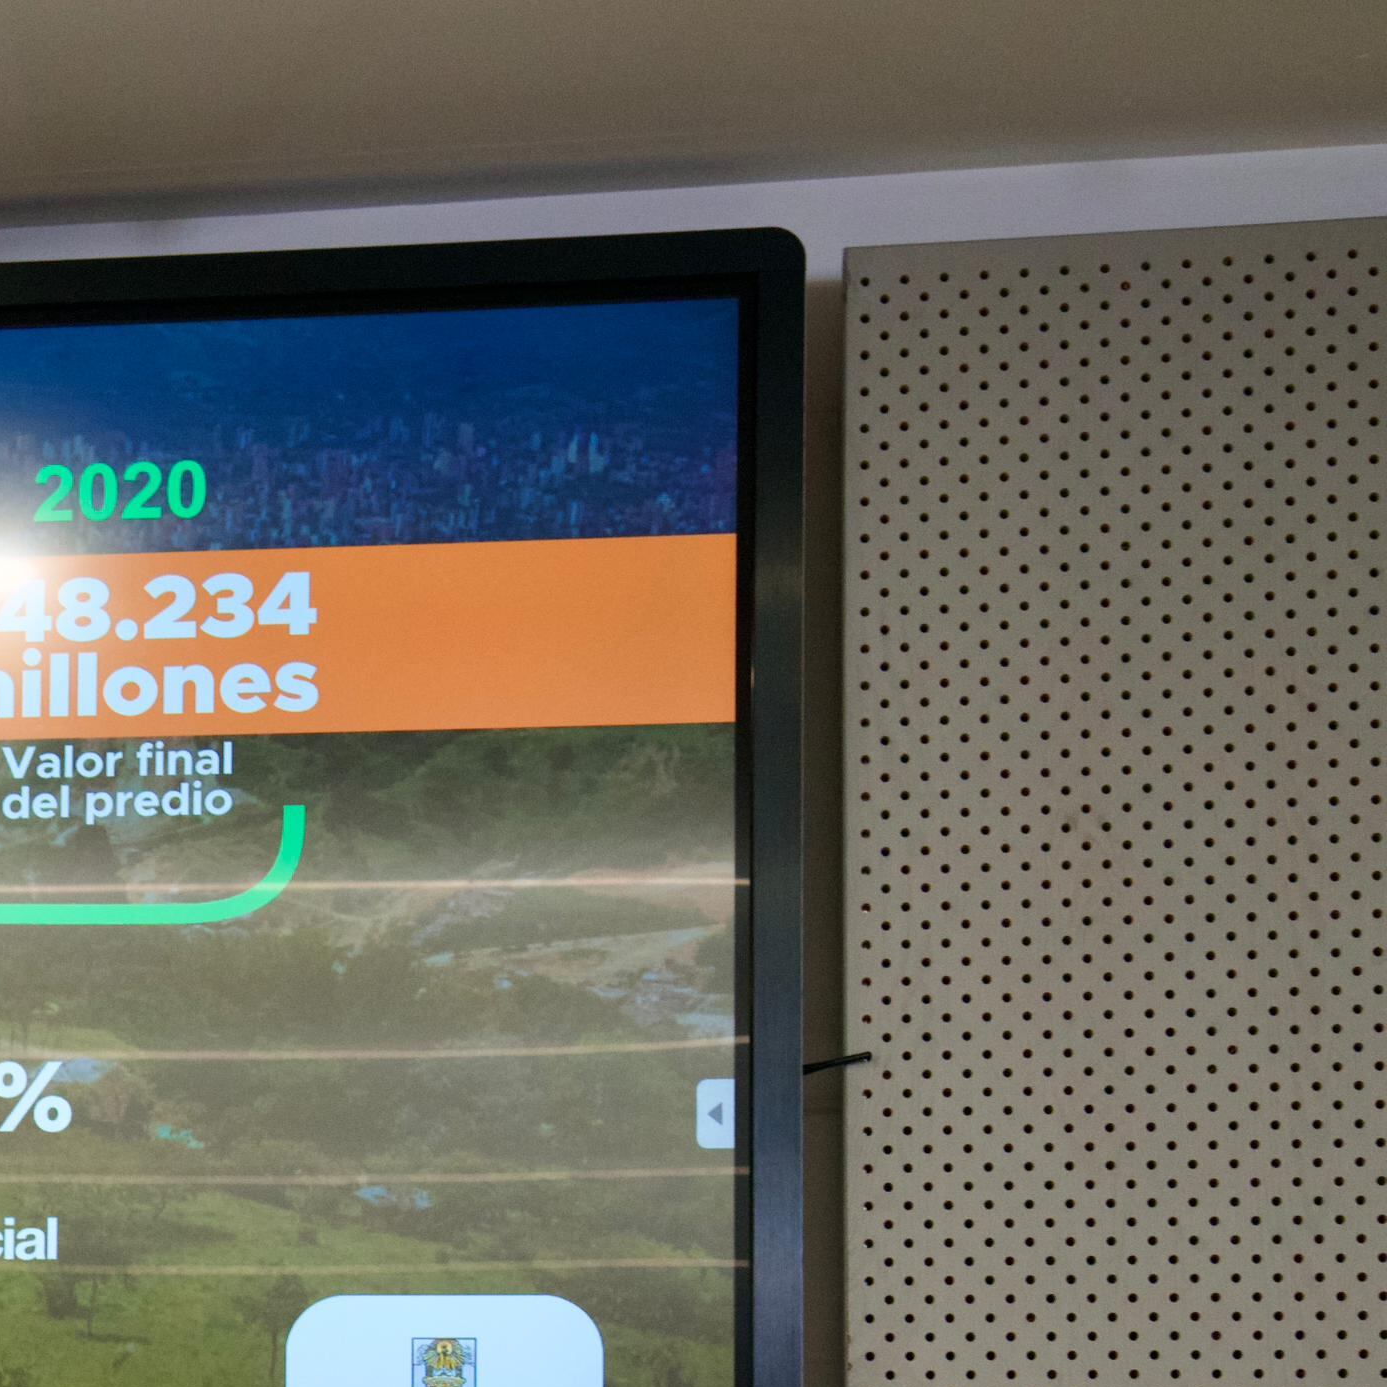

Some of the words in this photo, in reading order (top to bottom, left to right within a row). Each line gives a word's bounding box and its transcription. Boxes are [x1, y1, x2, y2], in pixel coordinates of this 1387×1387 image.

[33, 460, 207, 523] 2020
[2, 745, 123, 779] Valor
[135, 741, 233, 777] final
[2, 785, 70, 820] del
[85, 781, 233, 825] predio
